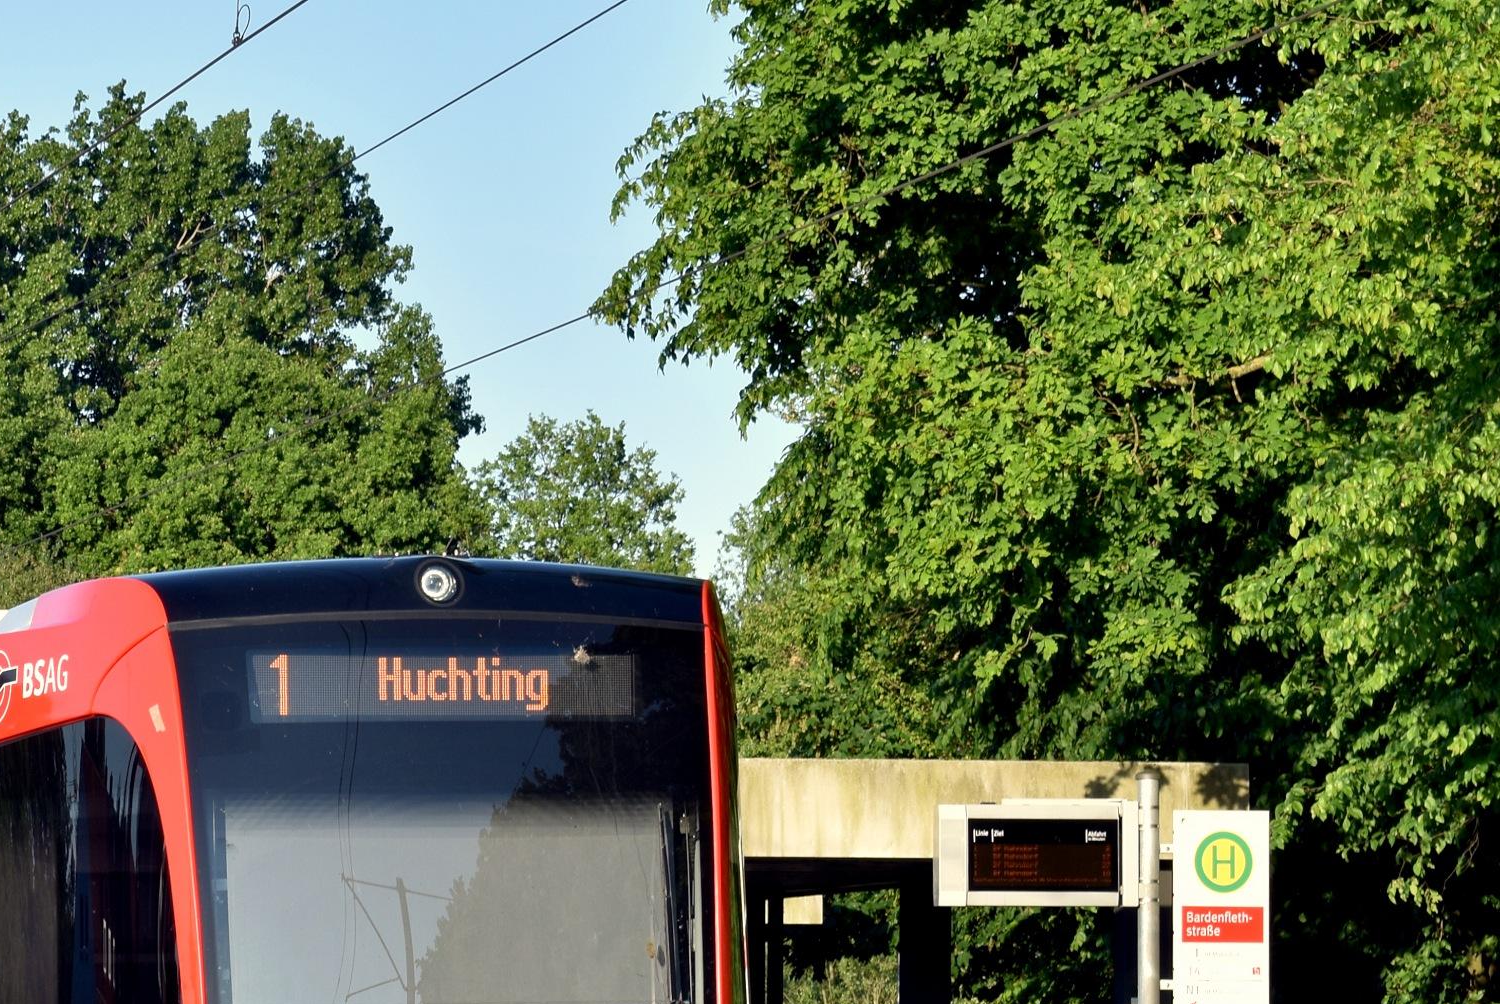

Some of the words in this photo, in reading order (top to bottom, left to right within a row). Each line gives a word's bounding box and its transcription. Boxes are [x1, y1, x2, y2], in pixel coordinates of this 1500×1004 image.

[22, 654, 69, 699] BSAG
[269, 654, 288, 716] 1
[378, 657, 548, 711] Huchting
[1212, 845, 1235, 879] H
[1186, 911, 1252, 923] Bardenfleth-
[1186, 925, 1221, 937] straße
